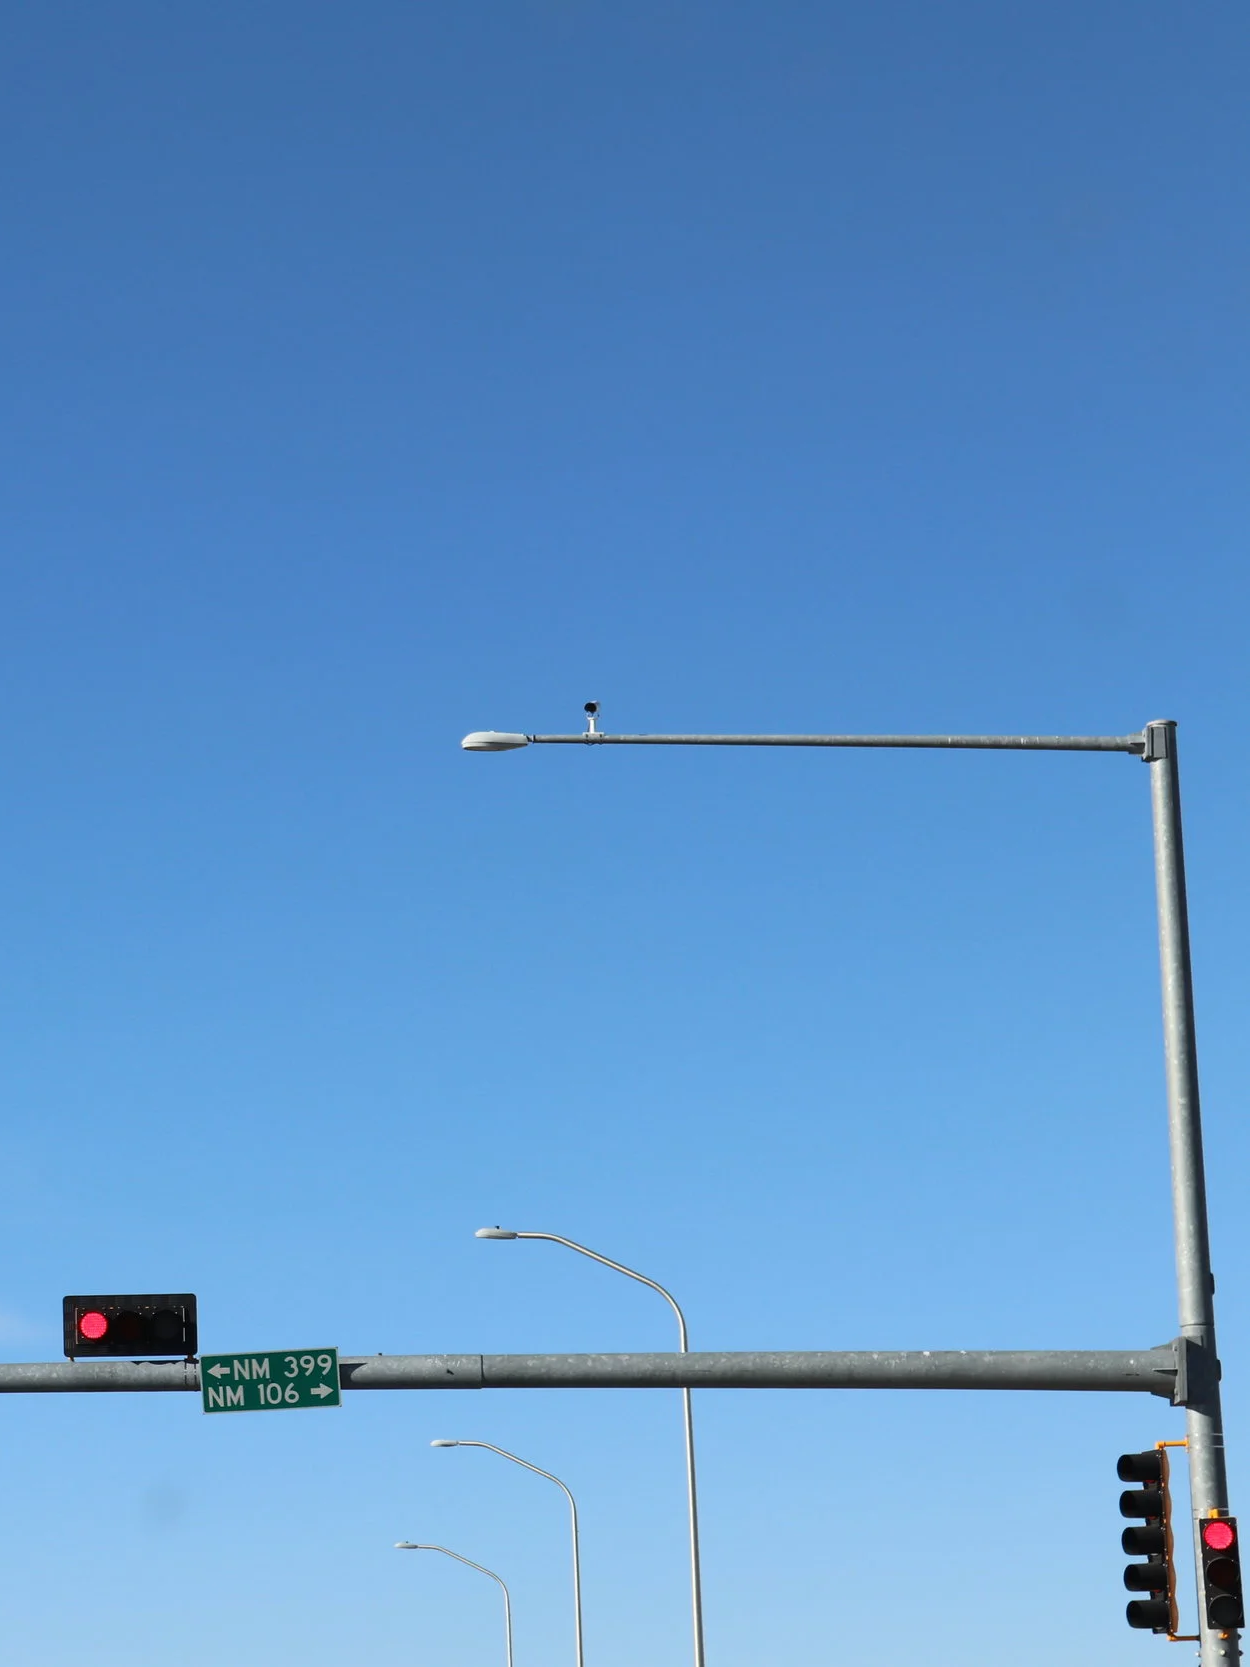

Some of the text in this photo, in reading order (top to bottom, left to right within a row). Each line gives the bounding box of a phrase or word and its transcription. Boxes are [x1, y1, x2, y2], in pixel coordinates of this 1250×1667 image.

[233, 1354, 332, 1380] NM 399
[208, 1382, 300, 1408] NM 106
